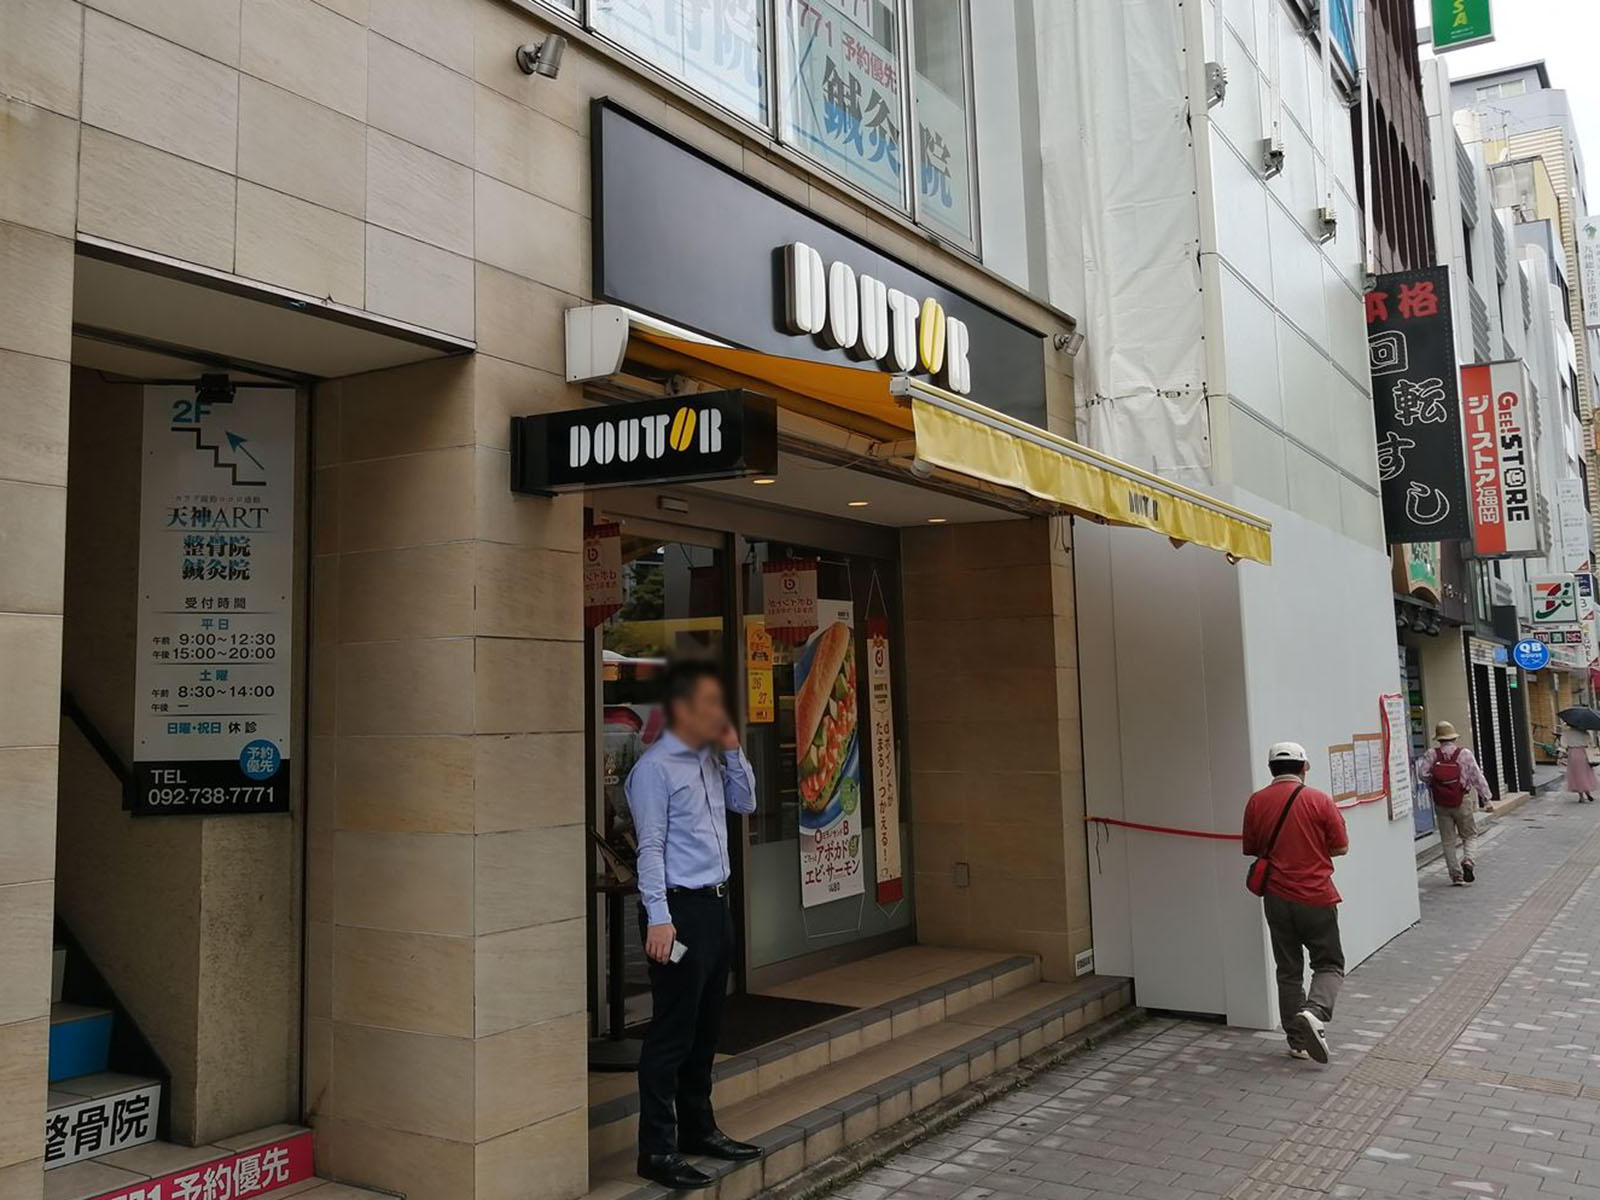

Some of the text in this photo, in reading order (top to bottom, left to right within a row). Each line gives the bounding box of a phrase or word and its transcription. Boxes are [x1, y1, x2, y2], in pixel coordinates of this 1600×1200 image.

[784, 241, 970, 395] DOUTOR
[172, 400, 211, 422] 2F
[569, 406, 722, 468] DOUTOR
[1467, 395, 1500, 525] ジーストア福岡
[183, 535, 252, 558] 整骨院
[184, 596, 247, 610] 受付時間
[200, 618, 230, 630] 平日
[1519, 642, 1543, 654] QB
[199, 669, 229, 682] 土曜
[247, 746, 274, 760] 予約
[151, 769, 188, 785] TEL
[816, 839, 849, 864] アボカド
[172, 1146, 290, 1200] 予約優先
